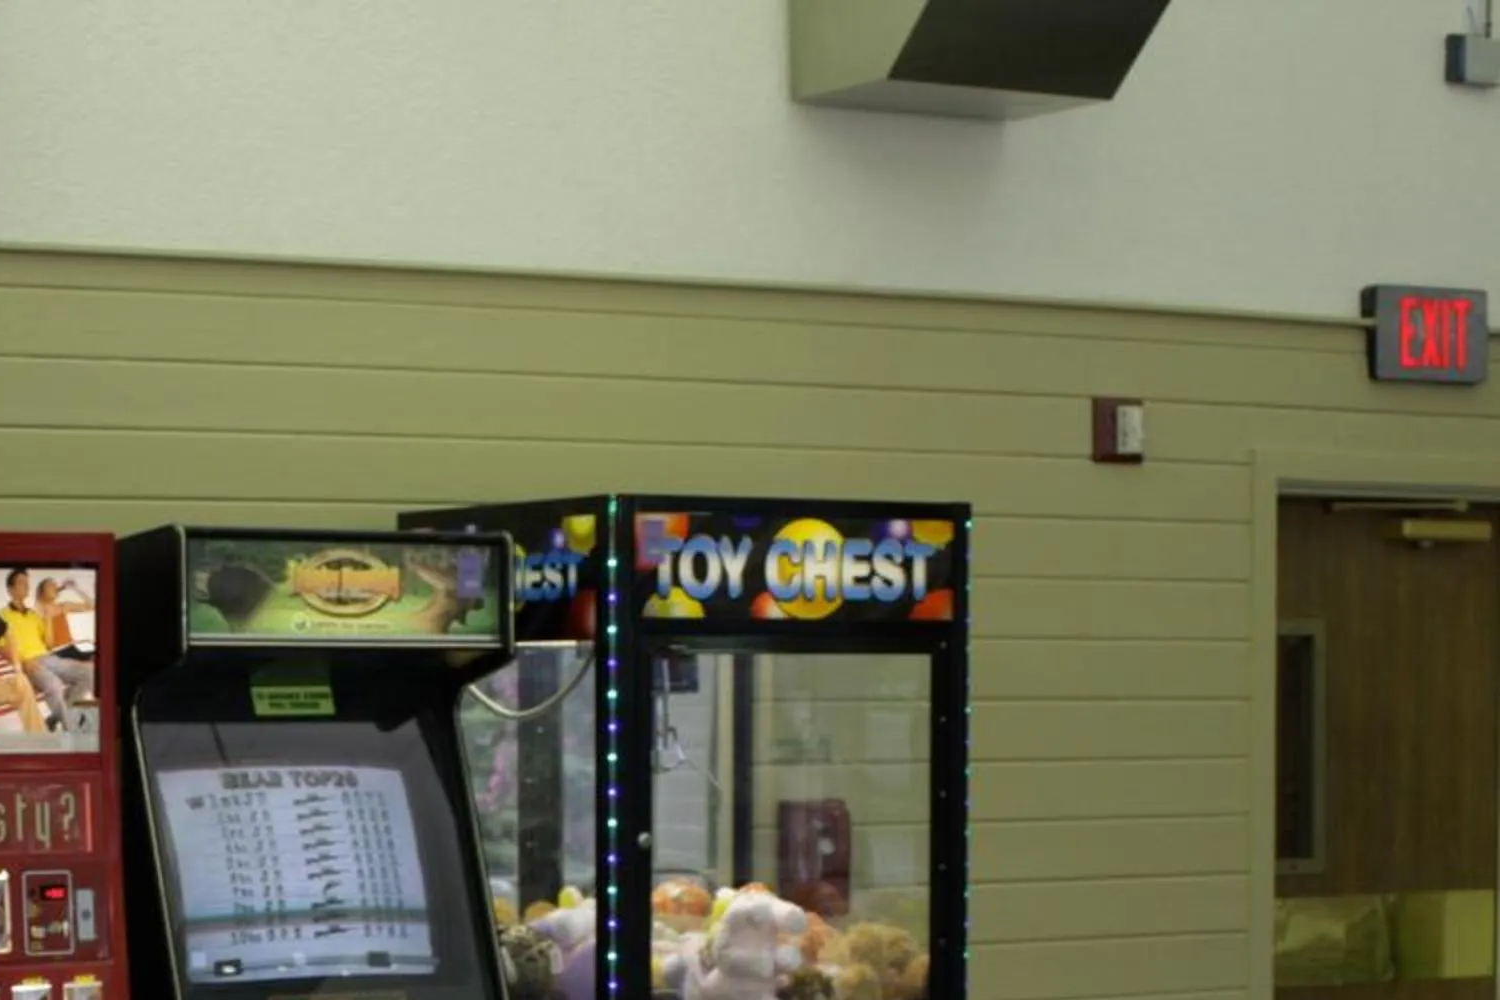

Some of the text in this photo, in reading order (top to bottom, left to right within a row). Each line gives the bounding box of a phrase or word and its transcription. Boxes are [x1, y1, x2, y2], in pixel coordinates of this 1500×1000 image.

[1400, 296, 1472, 370] EXIT
[515, 550, 584, 602] EST
[652, 534, 940, 602] TOY CHEST
